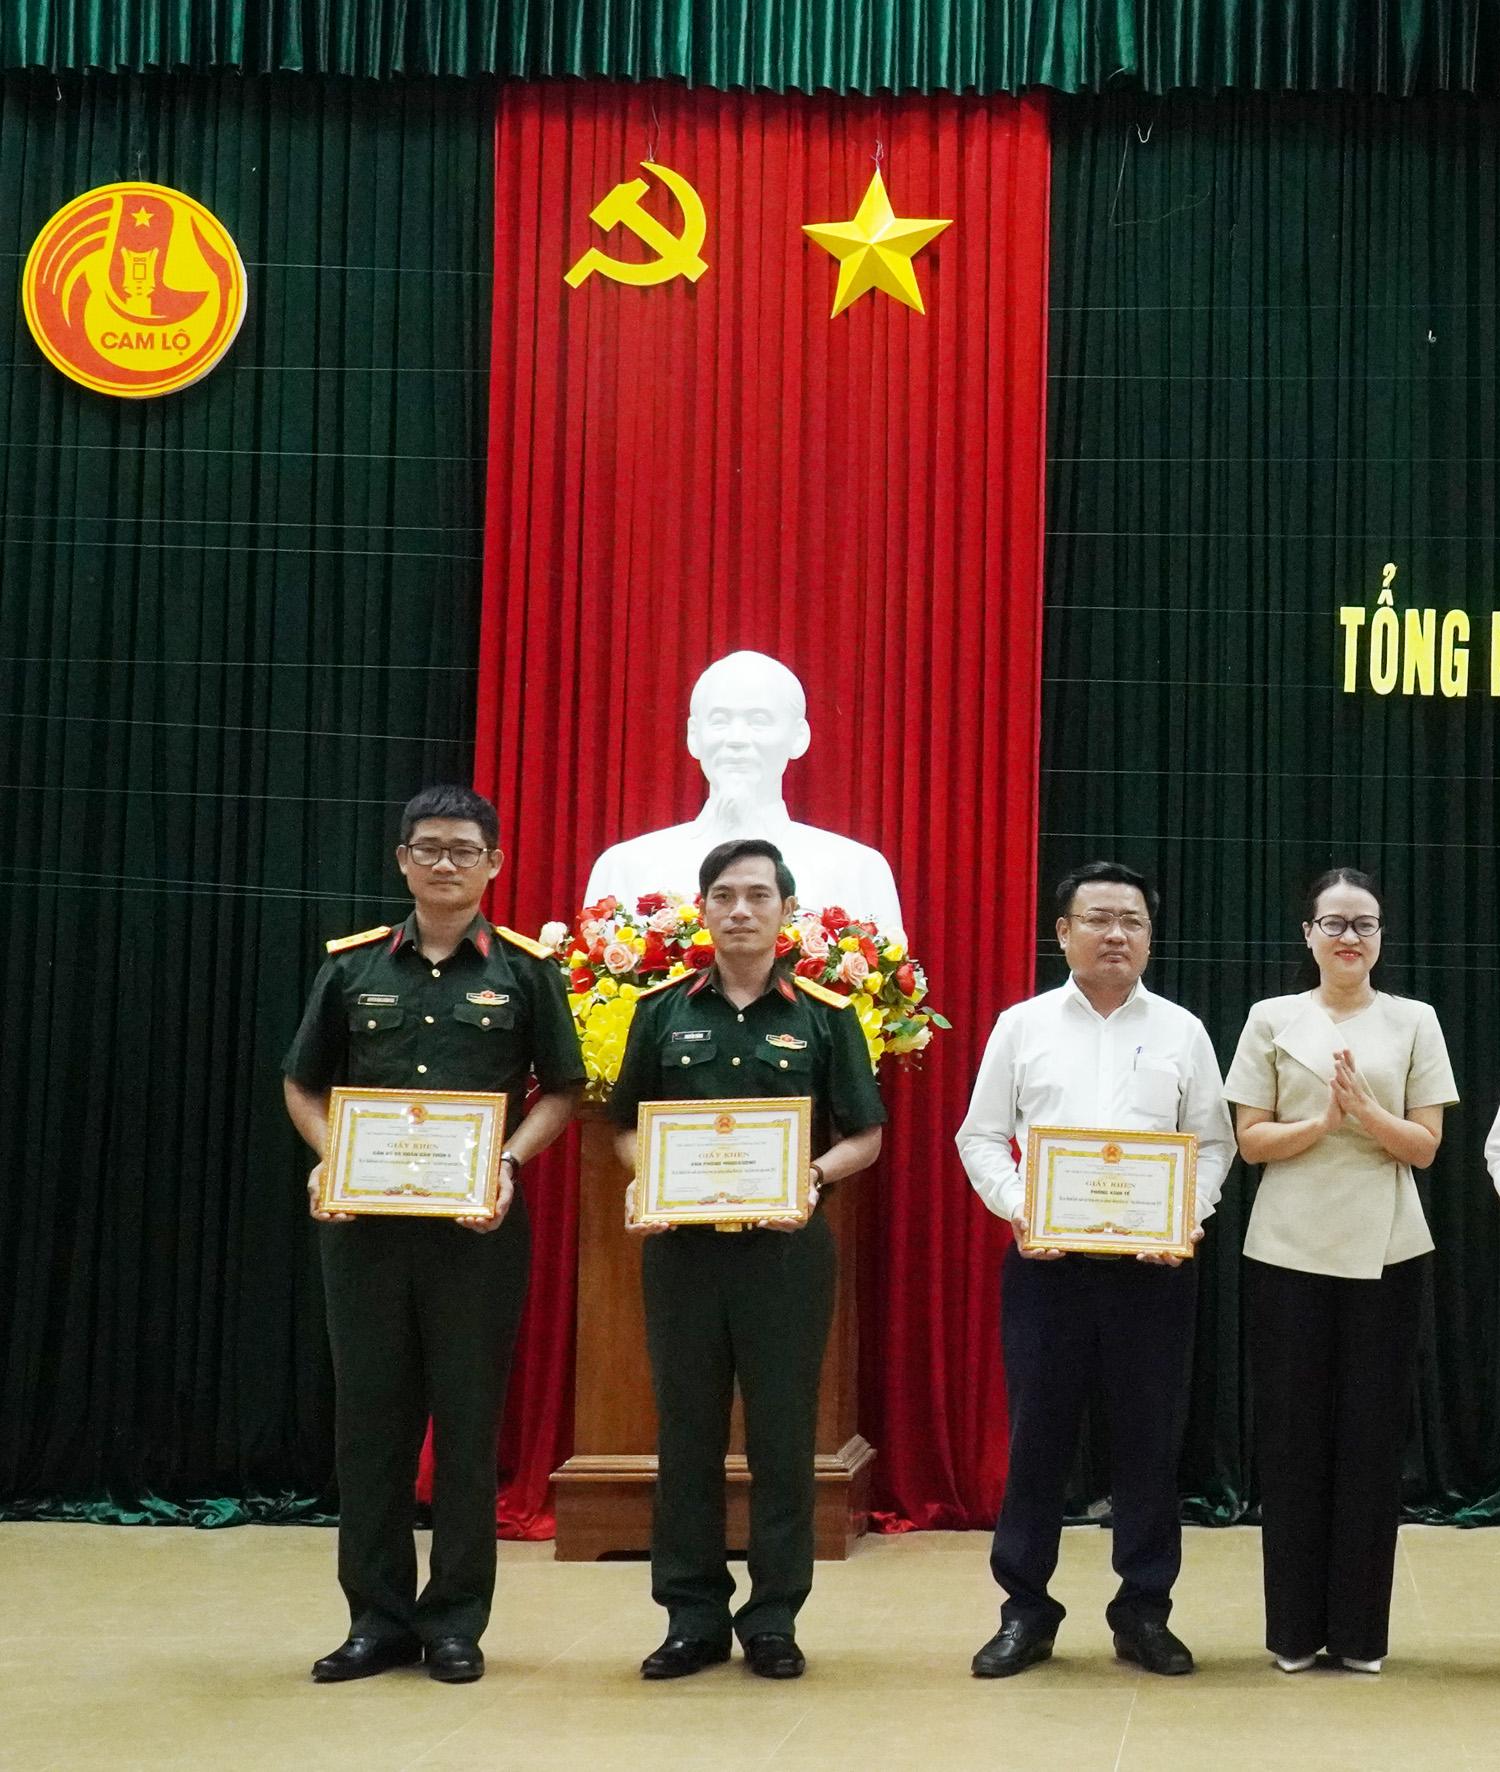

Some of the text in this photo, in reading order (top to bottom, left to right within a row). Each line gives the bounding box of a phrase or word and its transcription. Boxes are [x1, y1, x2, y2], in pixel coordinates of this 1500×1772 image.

[100, 328, 191, 356] CAM LỘ
[1341, 563, 1469, 697] TỔNG
